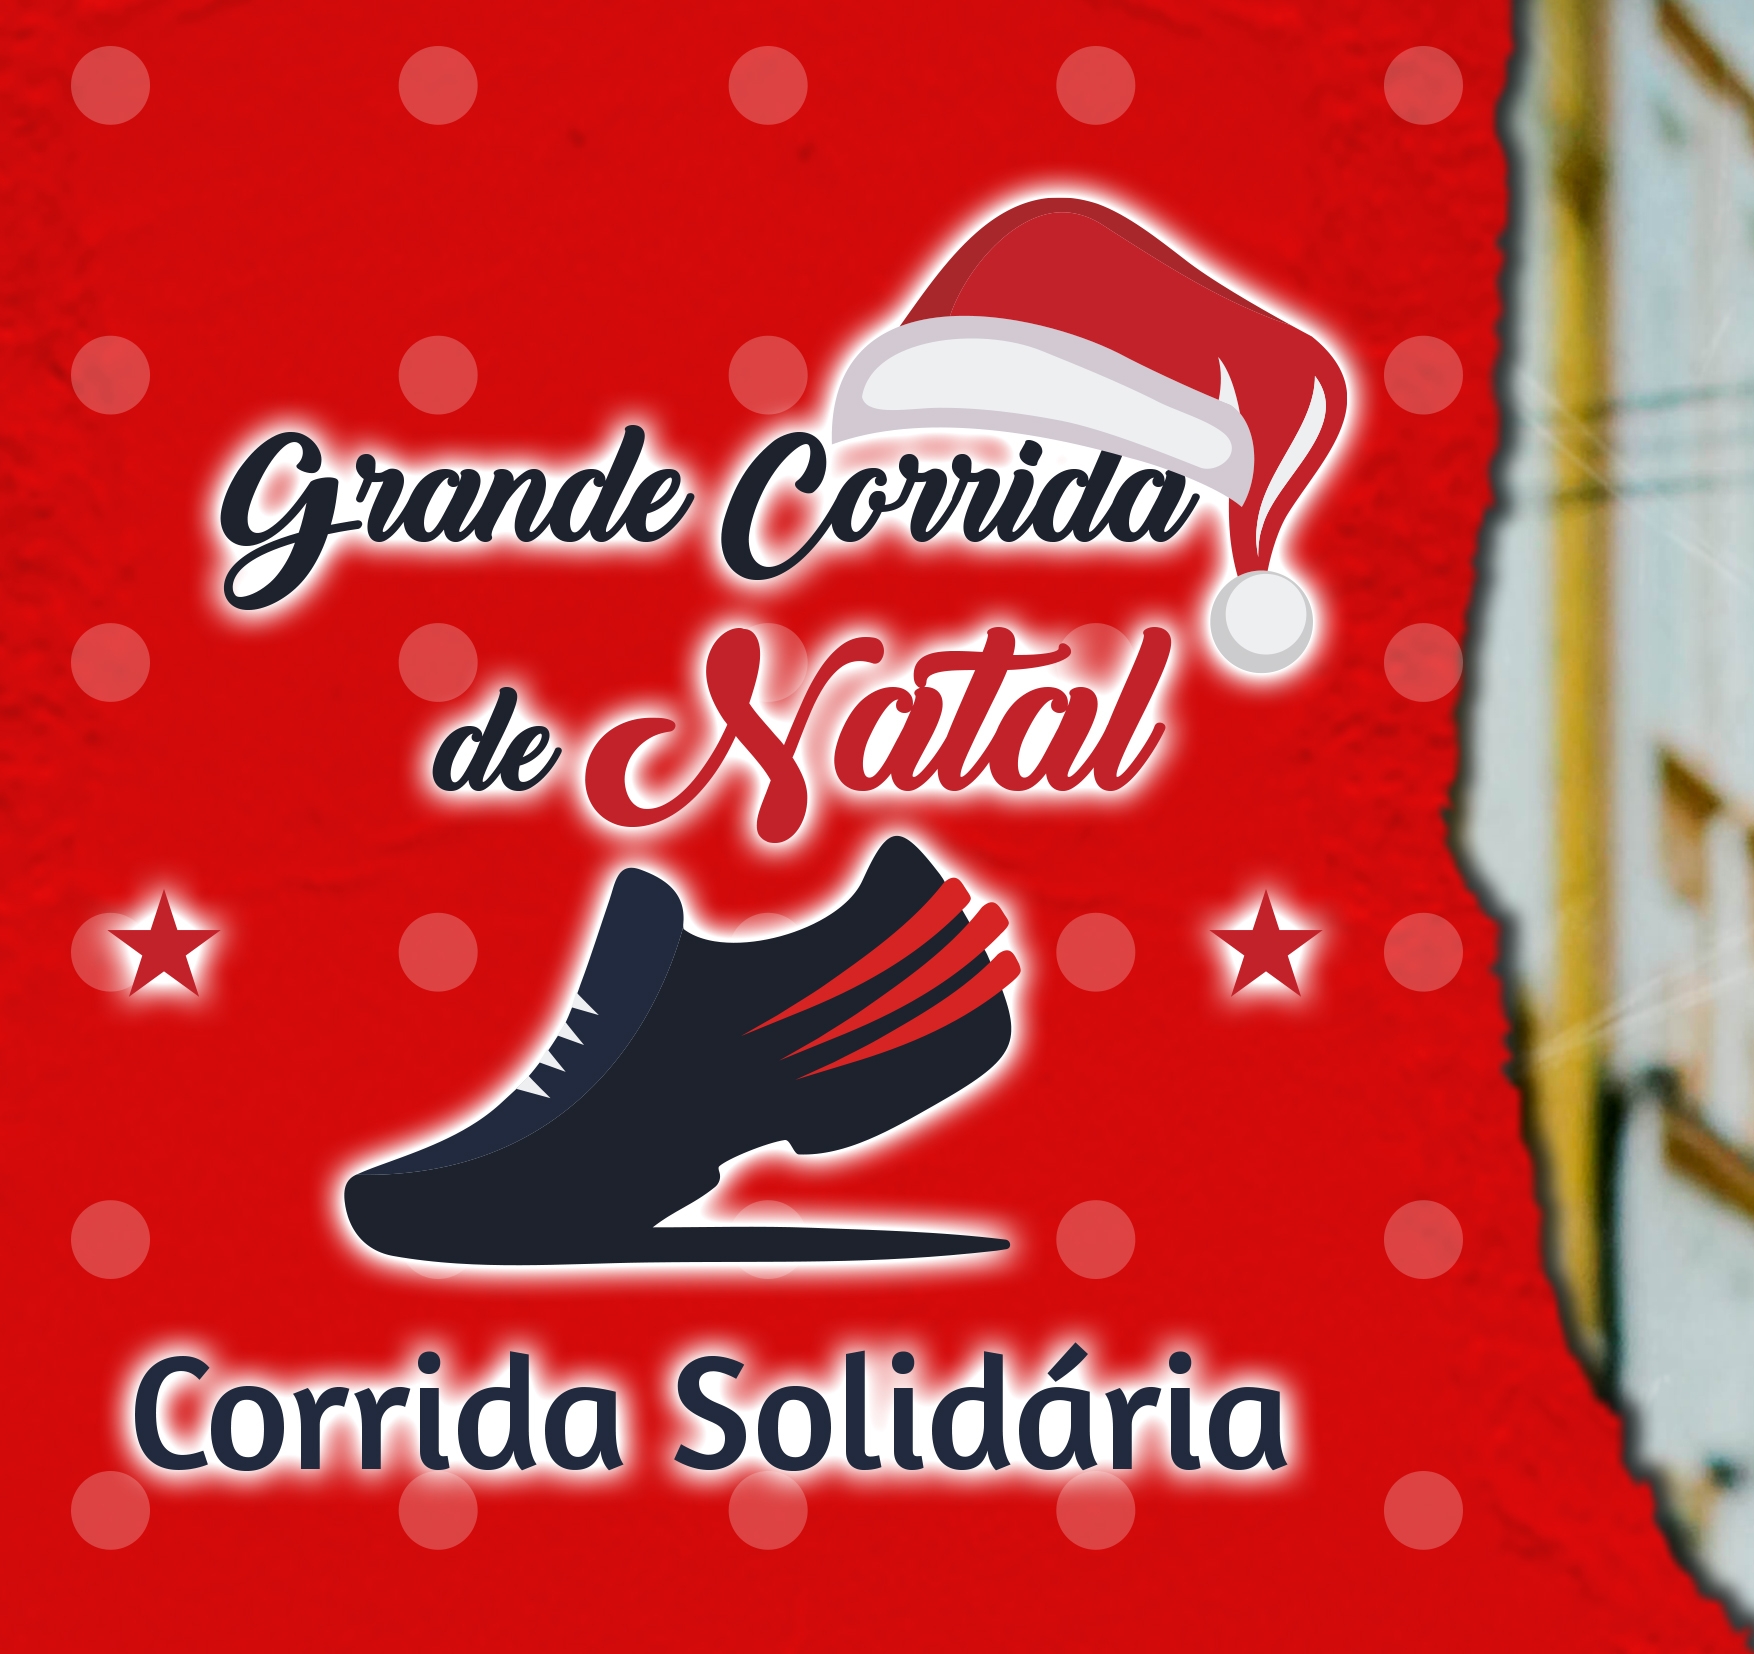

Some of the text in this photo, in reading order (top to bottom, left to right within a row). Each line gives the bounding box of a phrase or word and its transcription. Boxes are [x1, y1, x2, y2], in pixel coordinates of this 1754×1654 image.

[220, 425, 1200, 610] Grande Corrida
[431, 626, 1172, 844] de Natal
[133, 1342, 1288, 1472] Corrida Solidária
